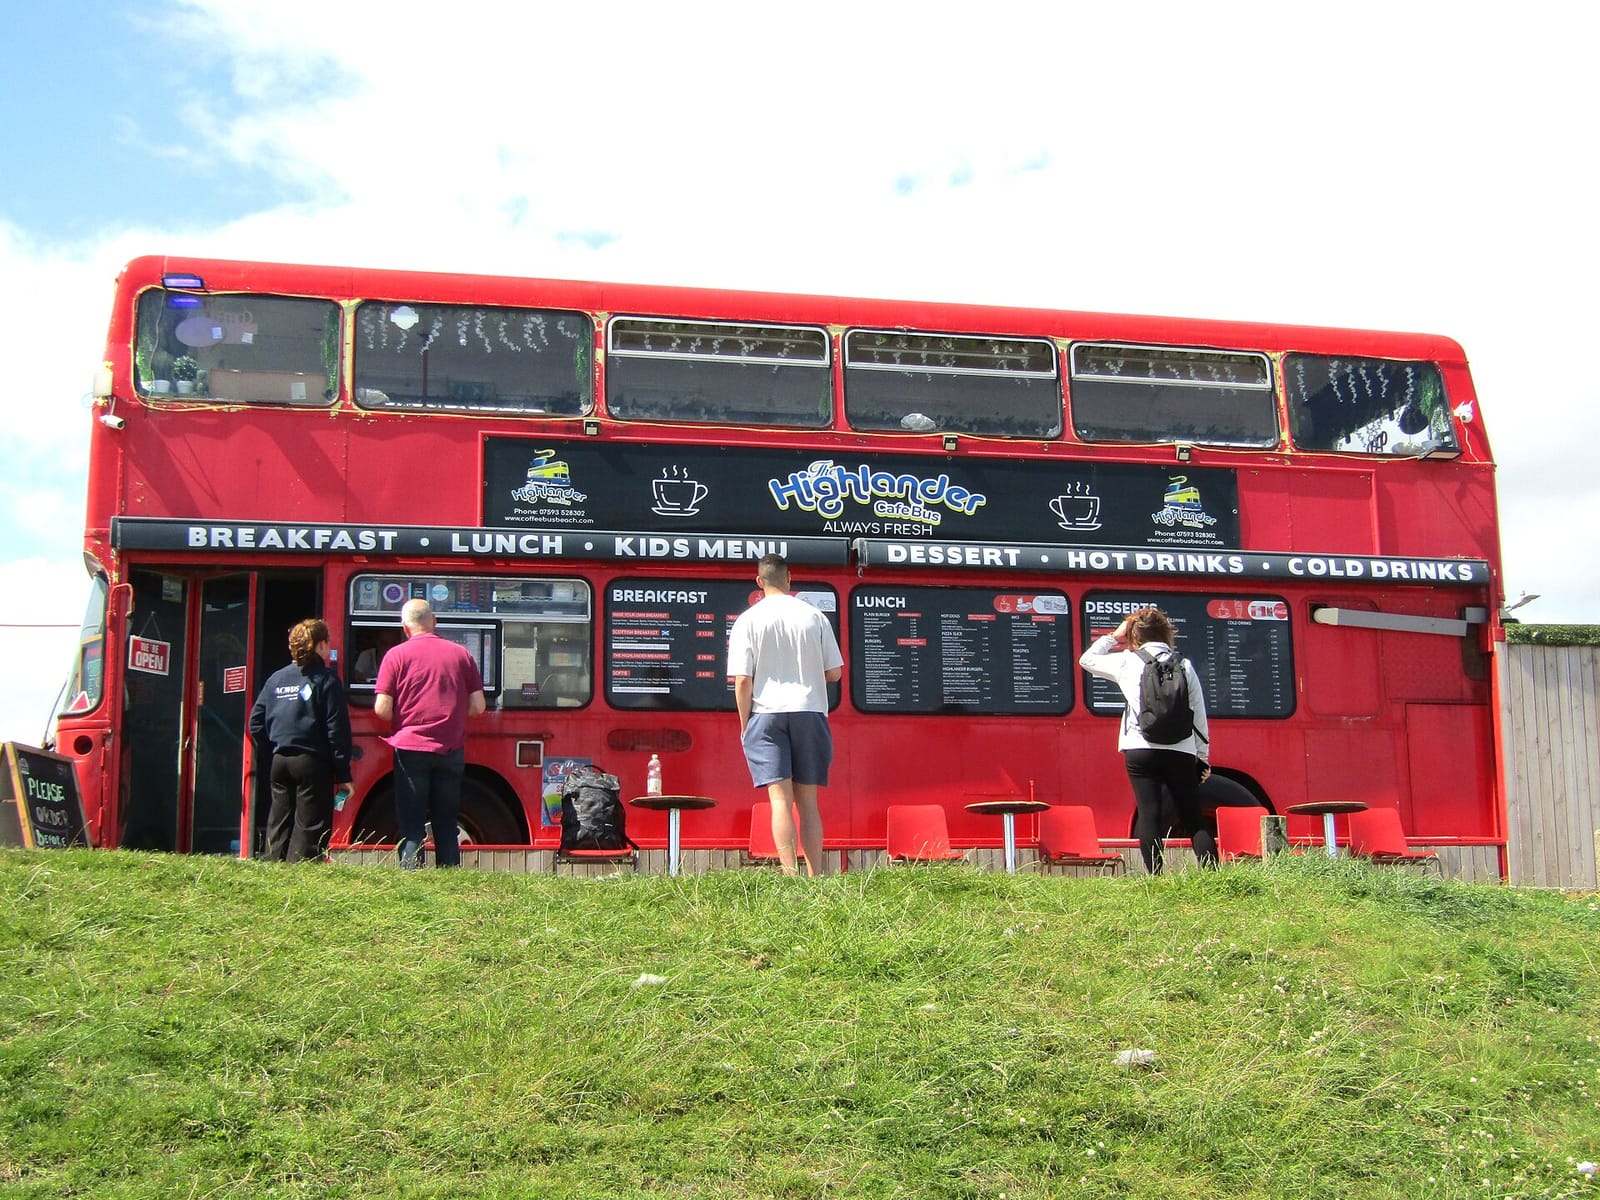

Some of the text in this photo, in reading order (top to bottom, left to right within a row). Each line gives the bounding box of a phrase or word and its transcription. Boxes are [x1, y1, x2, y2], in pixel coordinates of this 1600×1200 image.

[808, 460, 836, 478] The
[511, 485, 587, 503] Highlander
[769, 464, 987, 518] Highlander
[504, 516, 594, 524] www.coffeebusbeach.com
[1151, 509, 1217, 526] Highlander
[188, 527, 398, 550] BREAKFAST
[823, 521, 932, 536] ALWAYS FRESH
[451, 533, 563, 555] LUNCH
[614, 537, 787, 560] KIDS MENU
[887, 544, 1020, 566] DESSERT
[1067, 551, 1244, 574] HOT DRINKS
[1288, 558, 1473, 581] COLD DRINKS
[612, 589, 708, 604] BREAKFAST
[856, 596, 906, 609] LUNCH
[135, 650, 164, 670] OPEN
[27, 777, 65, 802] PLEASE
